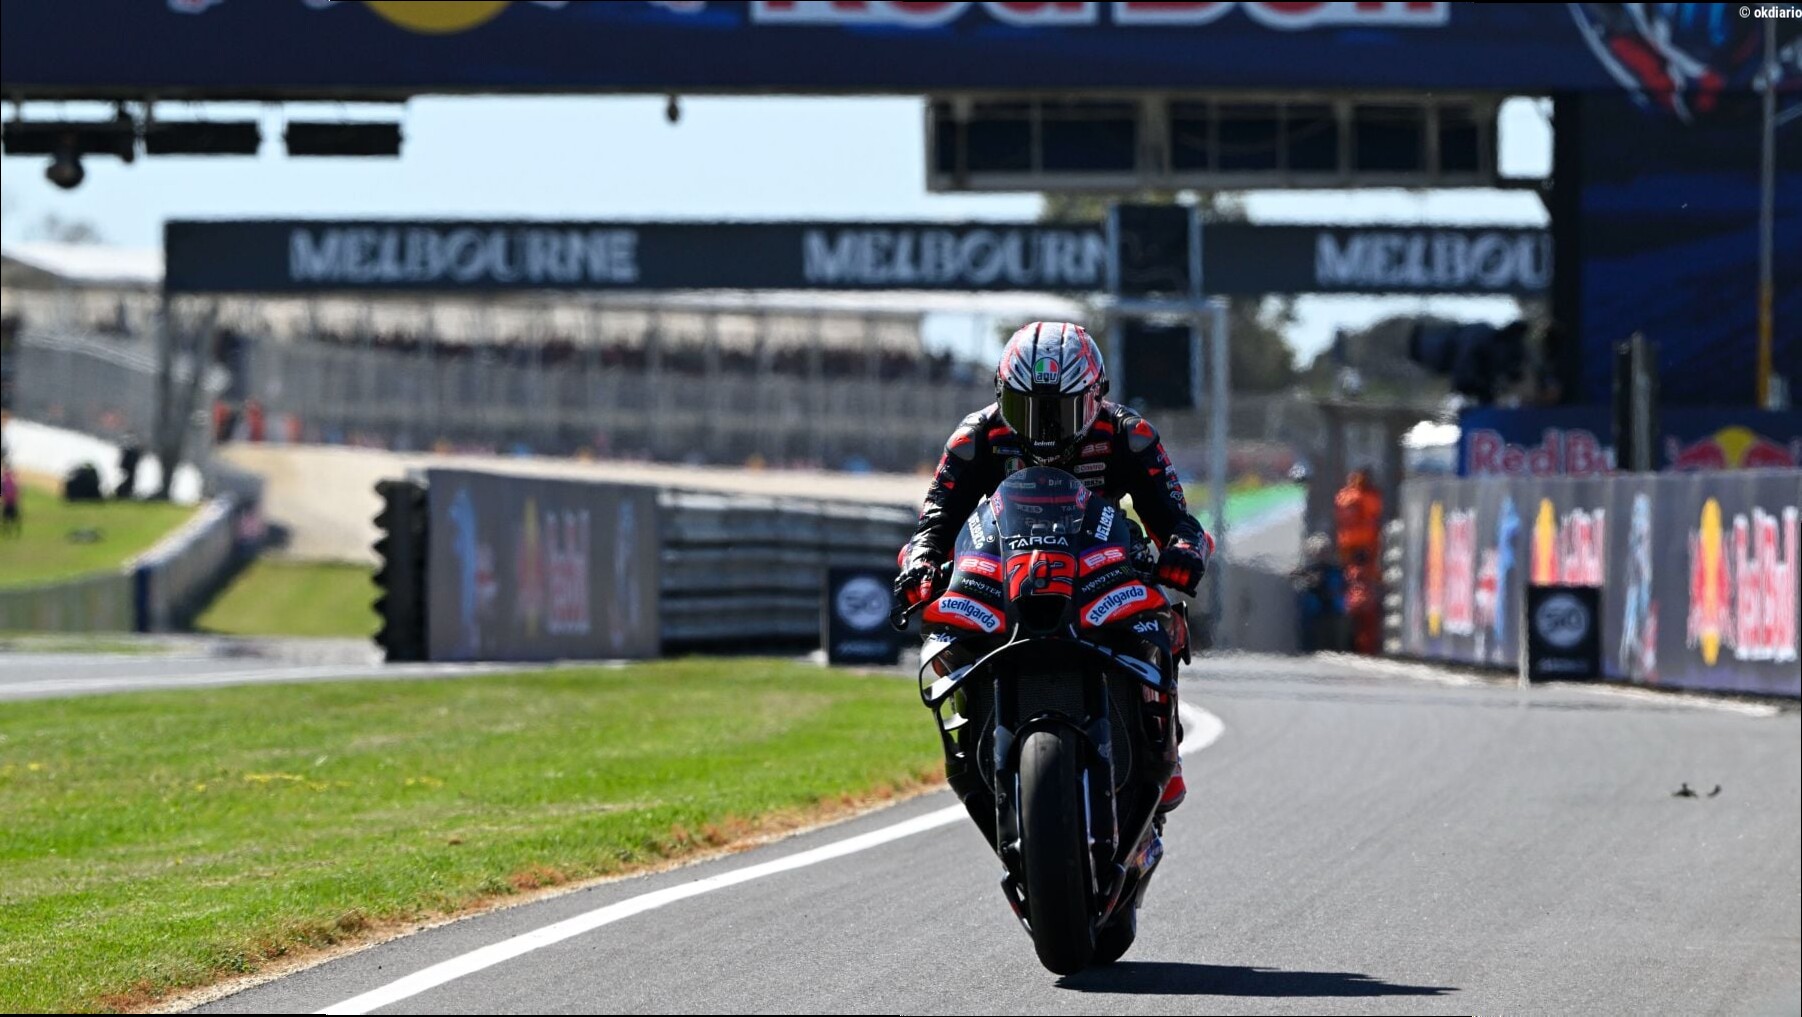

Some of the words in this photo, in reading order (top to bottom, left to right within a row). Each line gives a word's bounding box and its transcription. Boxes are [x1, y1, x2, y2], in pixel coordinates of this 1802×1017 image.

[289, 228, 639, 283] MELBOURNE
[802, 229, 1109, 285] MELBOURN
[1314, 231, 1554, 288] MELBOU
[1468, 427, 1560, 476] Red
[1008, 535, 1069, 550] TARGA
[1084, 549, 1123, 568] BS
[961, 558, 998, 574] BS
[1006, 550, 1077, 601] 72
[941, 599, 996, 629] sterilgarda
[1090, 586, 1144, 622] sterilgarda
[1133, 619, 1159, 633] sky
